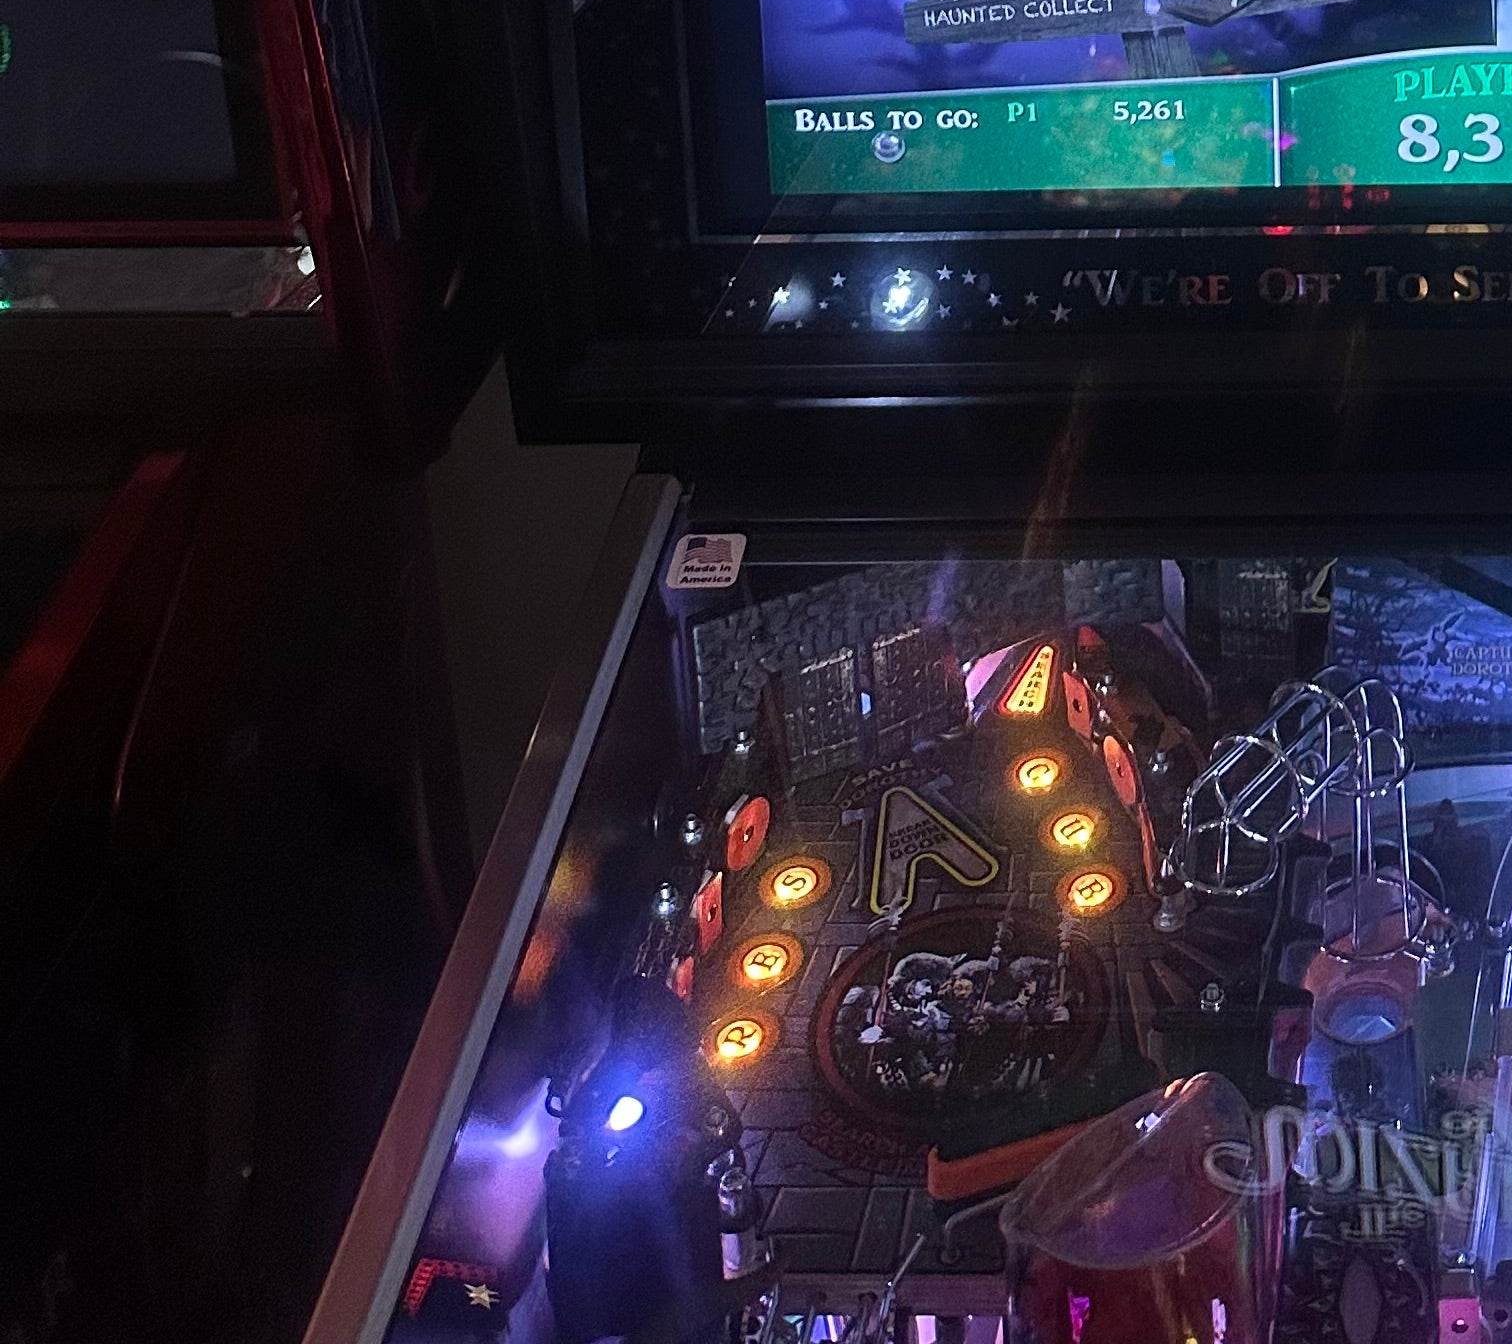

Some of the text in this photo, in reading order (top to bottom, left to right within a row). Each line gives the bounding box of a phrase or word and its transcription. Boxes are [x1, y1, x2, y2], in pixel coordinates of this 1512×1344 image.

[923, 3, 1017, 28] HAUNTED
[1006, 101, 1038, 123] P1
[1112, 99, 1186, 123] 5,261
[679, 574, 732, 585] America
[683, 564, 732, 574] Made in
